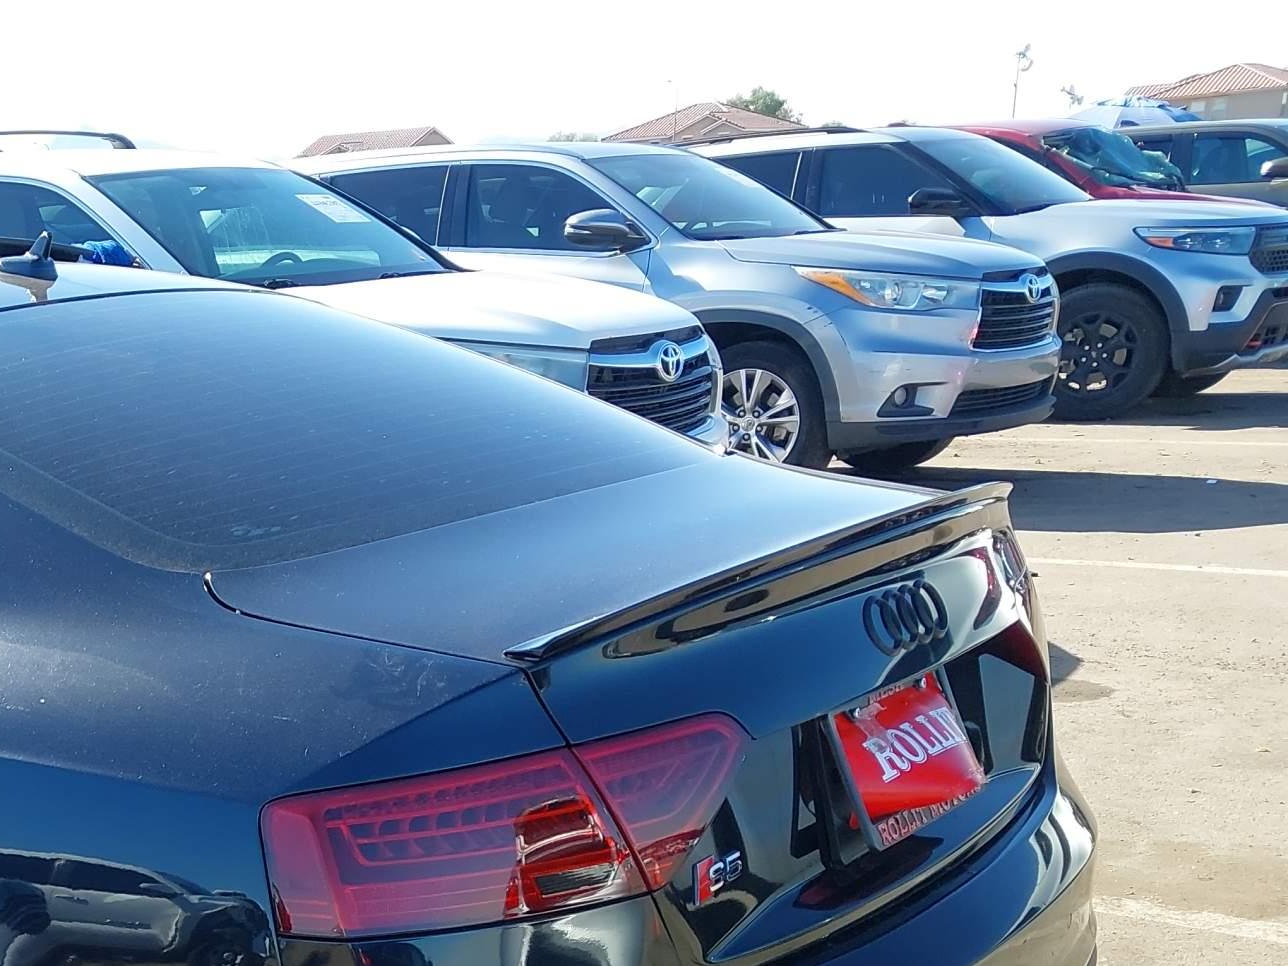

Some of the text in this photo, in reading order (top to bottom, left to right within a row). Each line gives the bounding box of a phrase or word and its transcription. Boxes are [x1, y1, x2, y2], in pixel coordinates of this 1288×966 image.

[862, 706, 967, 782] ROLLI
[878, 806, 928, 847] ROLLIT
[709, 850, 743, 893] S5
